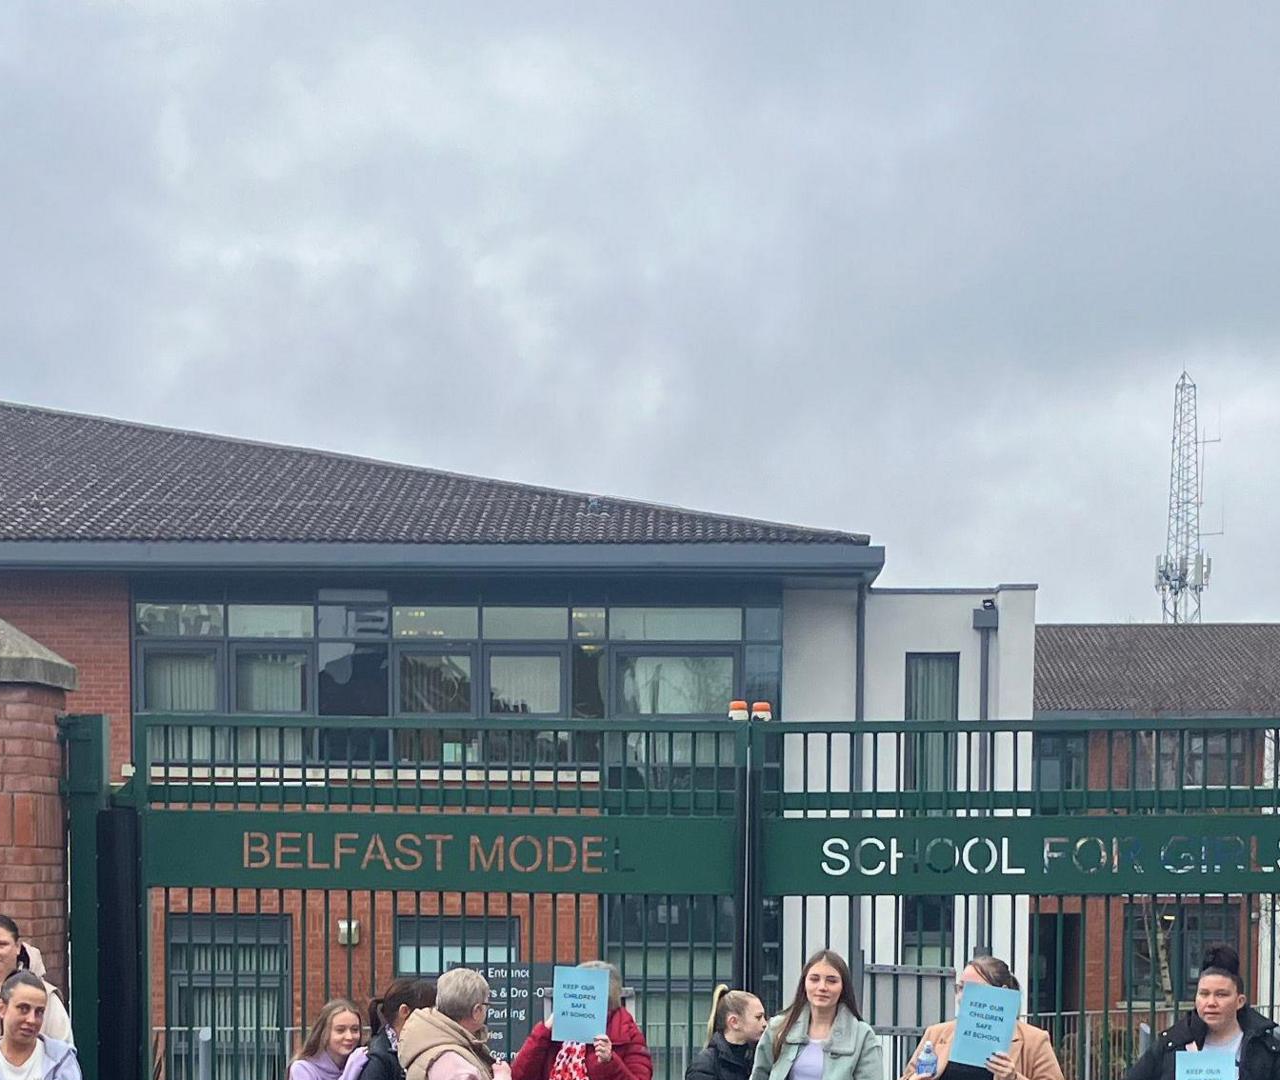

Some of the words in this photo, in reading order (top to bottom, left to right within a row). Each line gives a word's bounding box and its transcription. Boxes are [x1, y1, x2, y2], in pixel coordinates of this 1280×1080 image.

[242, 831, 454, 871] BELFAST
[468, 834, 636, 873] MODEL
[821, 837, 1026, 875] SCHOOL
[1043, 837, 1145, 873] FOR
[969, 1001, 987, 1009] KEEP
[570, 1011, 596, 1019] SCHOOL
[969, 1011, 1004, 1022] CHILDREN
[976, 1022, 992, 1030] SAFE
[973, 1032, 1000, 1042] SCHOOL
